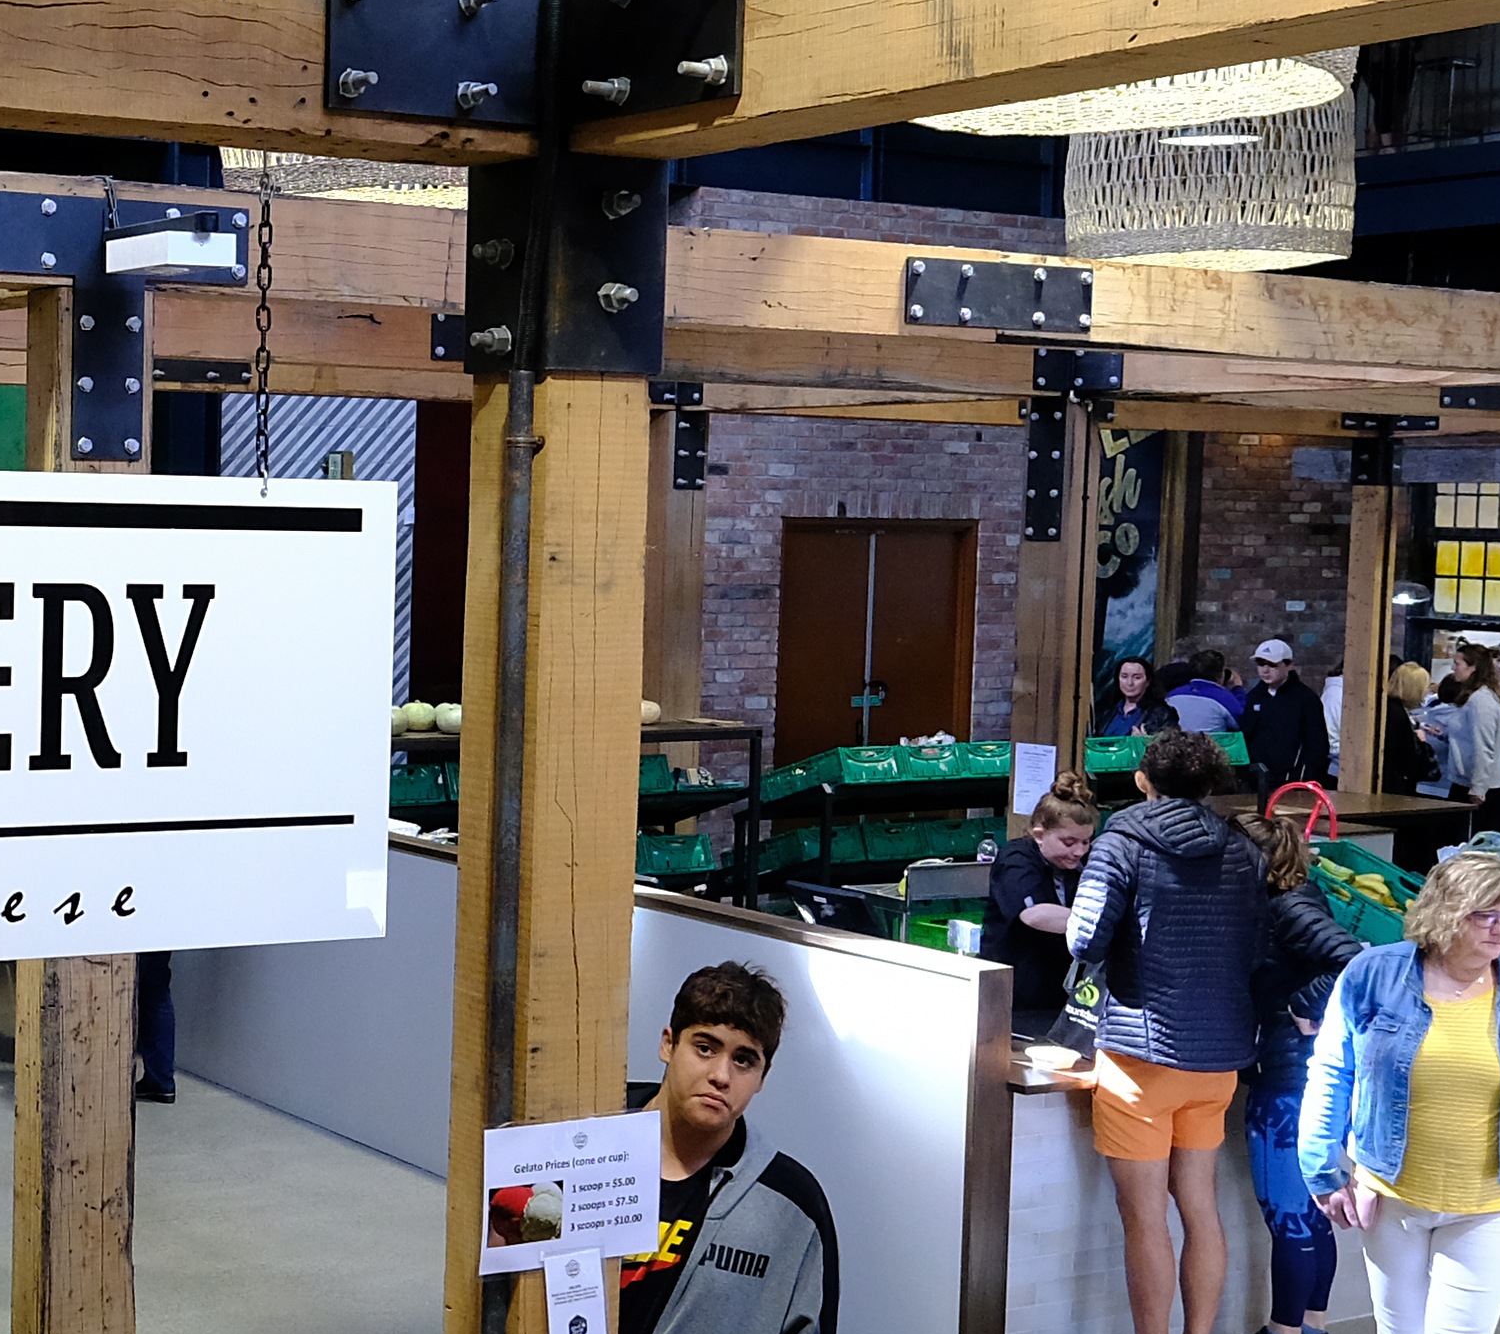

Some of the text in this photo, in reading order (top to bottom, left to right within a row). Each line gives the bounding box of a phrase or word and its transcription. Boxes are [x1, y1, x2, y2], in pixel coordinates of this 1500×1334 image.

[513, 1151, 630, 1175] Gelato Prices (cone or cup):
[579, 1181, 604, 1193] scoop
[612, 1176, 636, 1189] $5.00
[578, 1200, 607, 1212] scoops
[615, 1194, 639, 1208] $7.50
[576, 1219, 606, 1233] scoops
[614, 1213, 643, 1227] $10.00
[697, 1242, 771, 1279] PUMA
